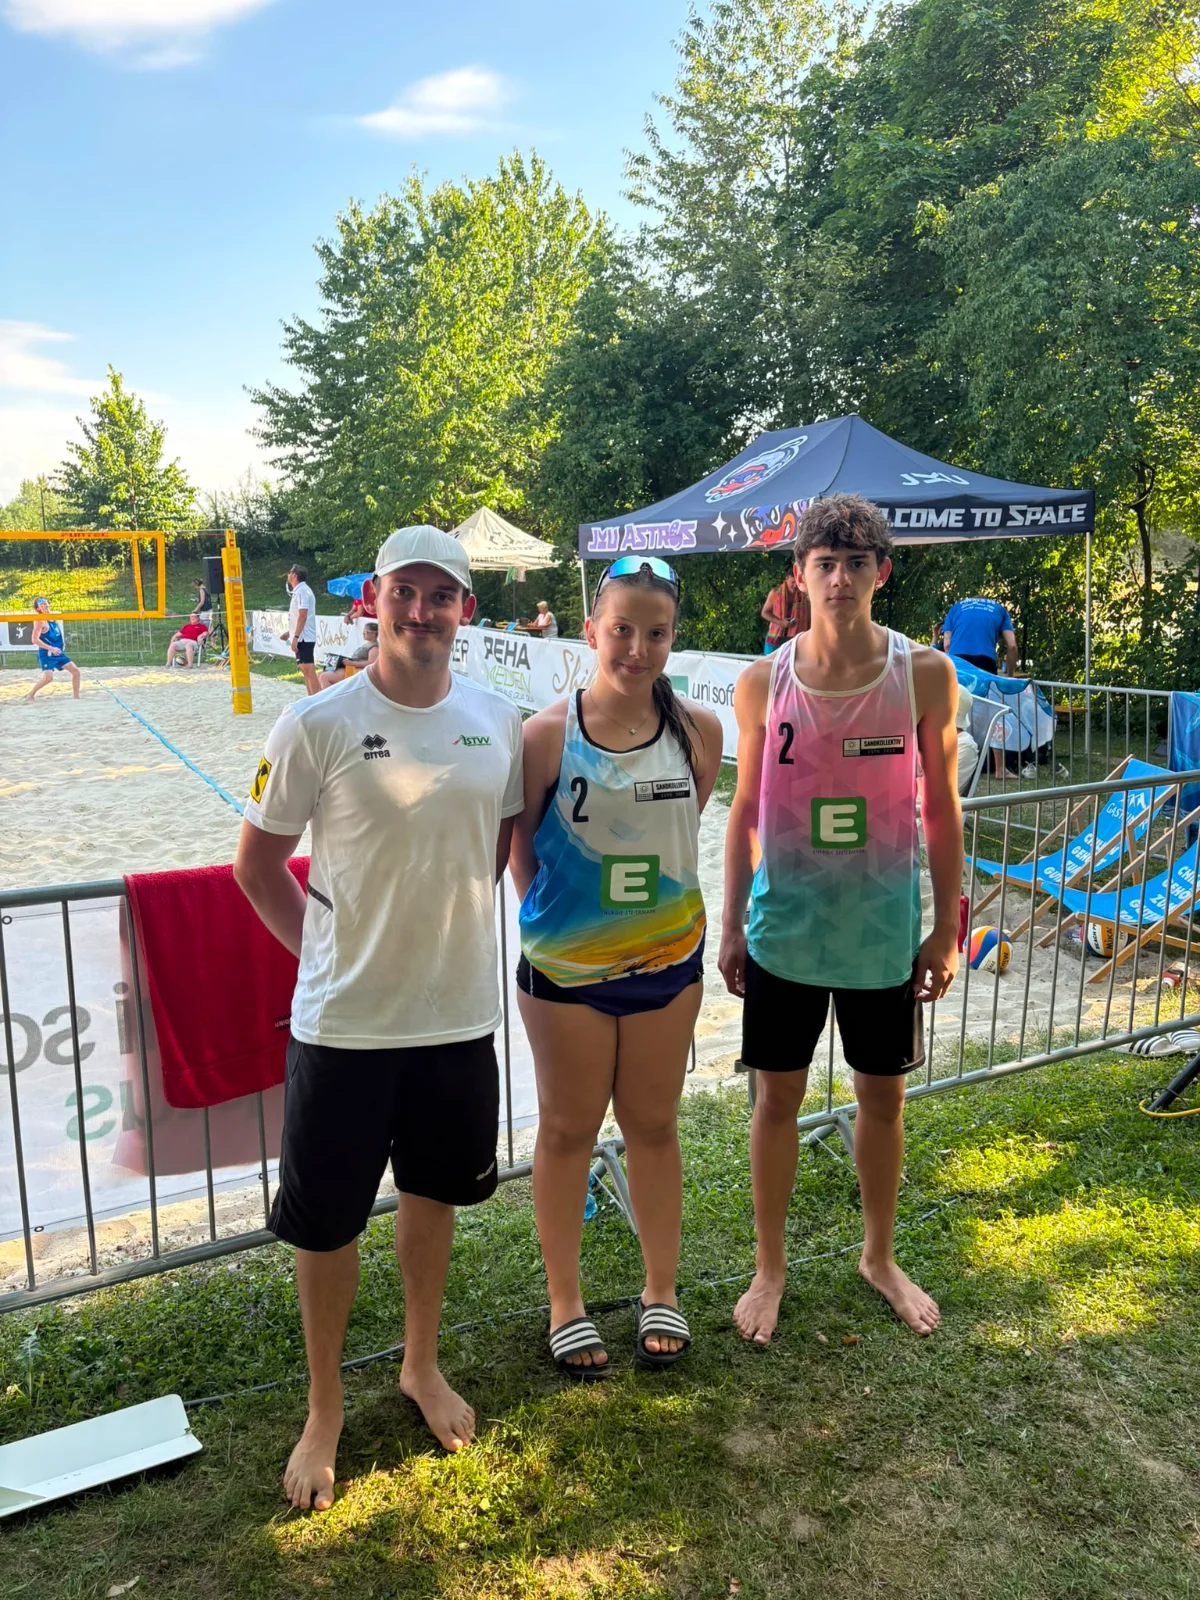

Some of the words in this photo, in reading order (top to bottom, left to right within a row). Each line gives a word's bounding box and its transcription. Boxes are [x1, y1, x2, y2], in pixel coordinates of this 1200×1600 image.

[880, 507, 965, 529] LCOME
[970, 508, 1003, 528] TO
[1006, 503, 1087, 527] SPACE
[621, 519, 698, 551] ASTROS
[483, 636, 531, 670] PEHA
[692, 680, 711, 702] uni
[363, 749, 391, 760] errea
[778, 722, 794, 765] 2
[570, 776, 589, 822] 2
[820, 804, 859, 843] E
[609, 862, 650, 902] E
